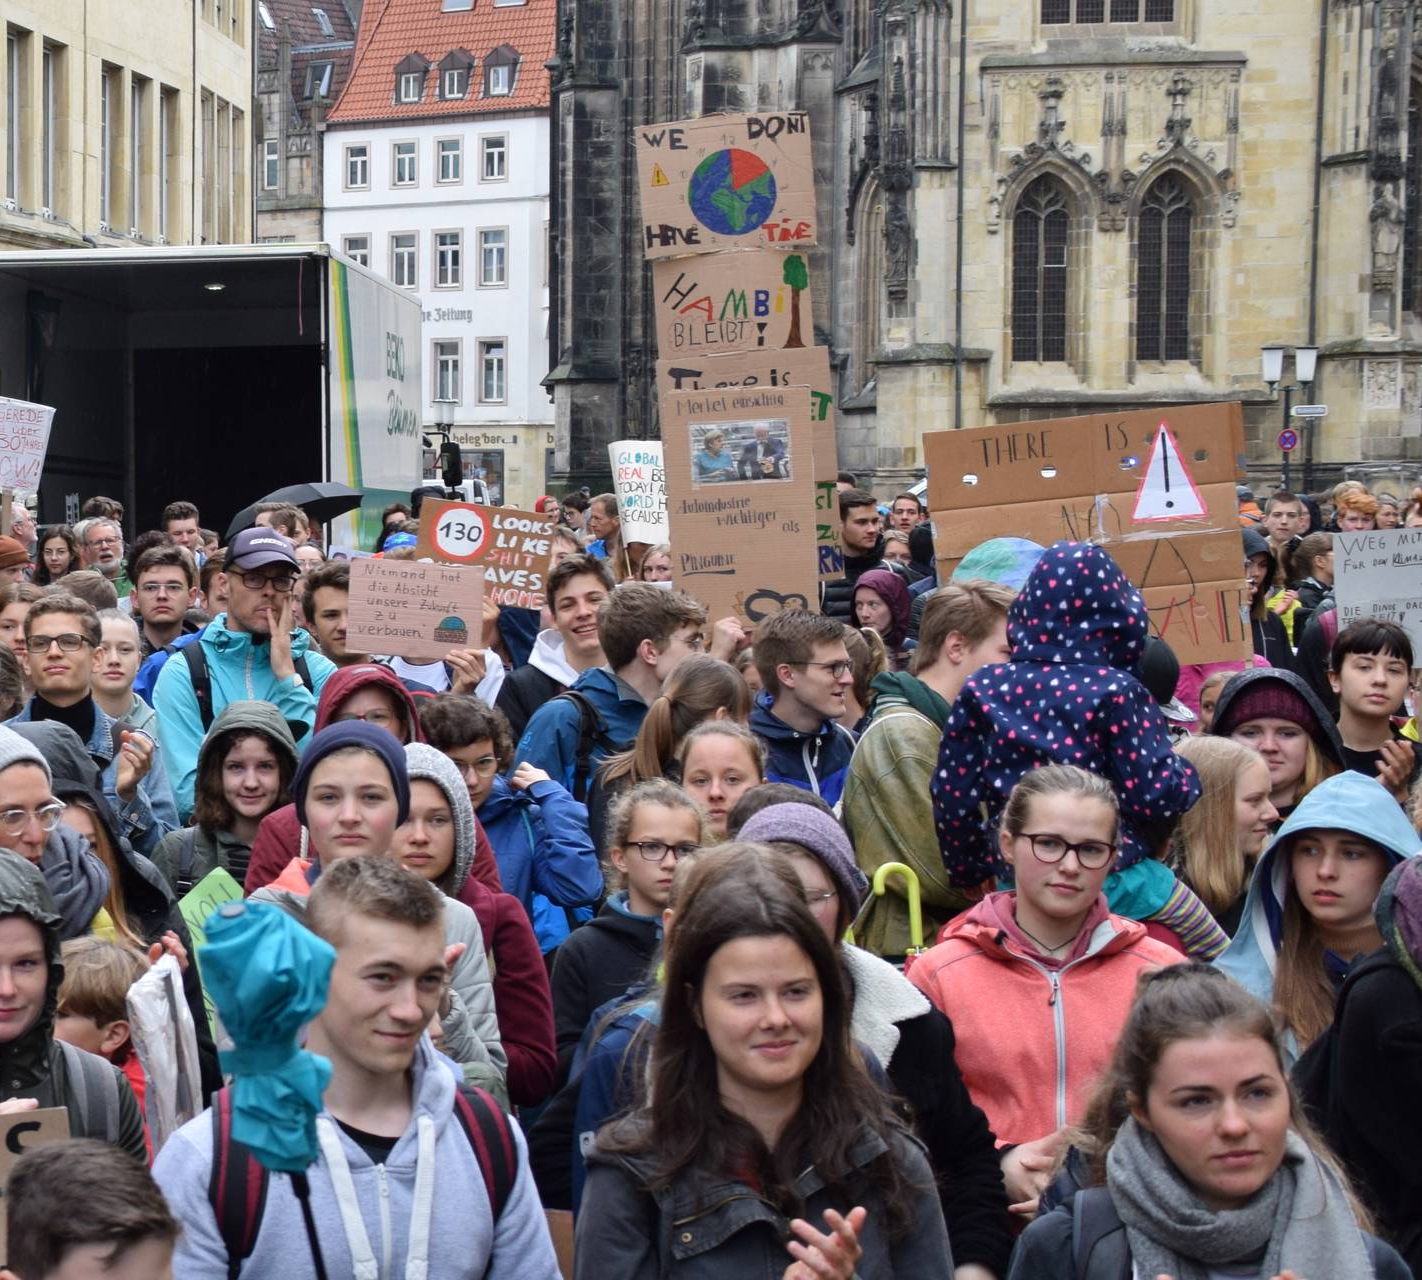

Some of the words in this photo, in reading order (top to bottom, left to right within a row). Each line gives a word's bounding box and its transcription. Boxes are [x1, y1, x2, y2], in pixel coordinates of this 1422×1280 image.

[643, 129, 688, 150] WE
[434, 308, 473, 323] Zeitung
[386, 331, 405, 383] BEKO
[972, 430, 1054, 467] THERE
[1105, 421, 1129, 450] IS
[618, 450, 661, 467] GLOBAL
[618, 466, 645, 481] REAL
[439, 522, 482, 542] 130
[492, 514, 554, 536] LOOKS
[1338, 534, 1387, 556] WEG
[485, 549, 534, 567] SHIT
[441, 570, 461, 582] hat
[368, 582, 389, 593] die
[394, 583, 439, 598] Absicht
[491, 586, 546, 610] HOME
[366, 598, 408, 609] unsere
[1344, 606, 1361, 617] DIE
